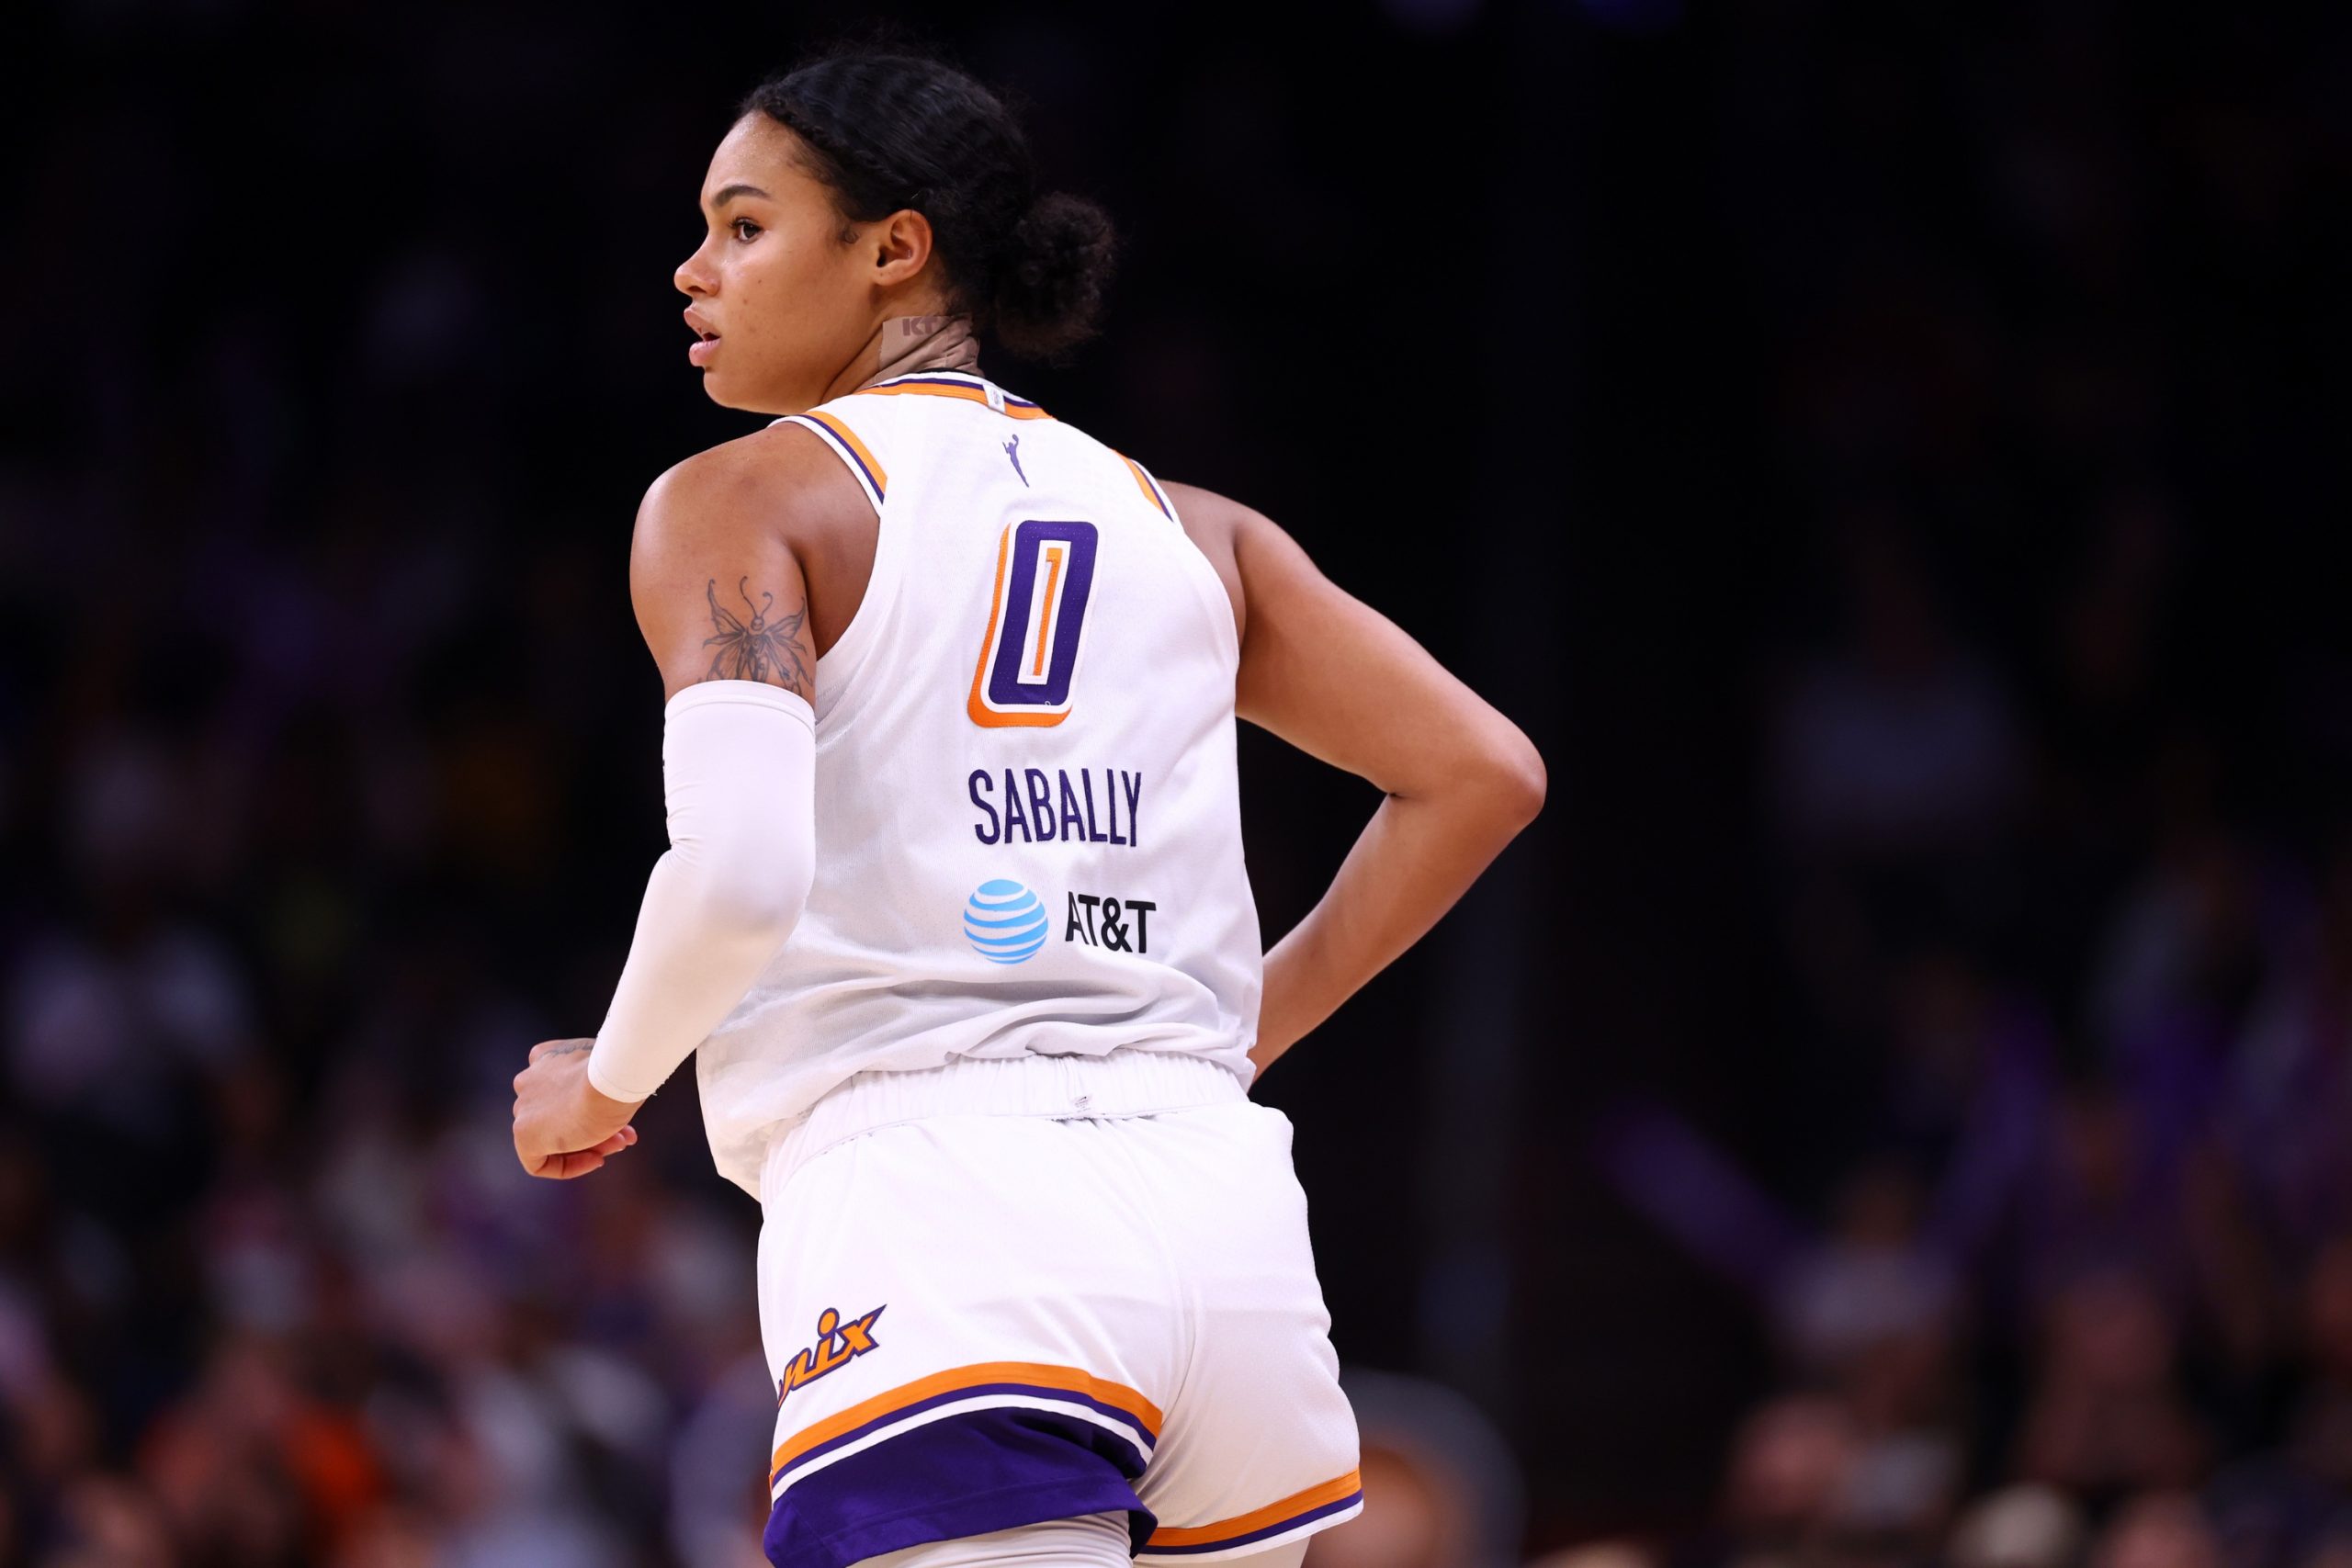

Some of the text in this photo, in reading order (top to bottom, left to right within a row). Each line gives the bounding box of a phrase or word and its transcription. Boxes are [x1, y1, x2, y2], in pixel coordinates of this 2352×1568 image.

[967, 520, 1100, 728] 0
[968, 768, 1141, 847] SABALLY
[1065, 891, 1157, 953] AT&T
[778, 1304, 887, 1408] nix
